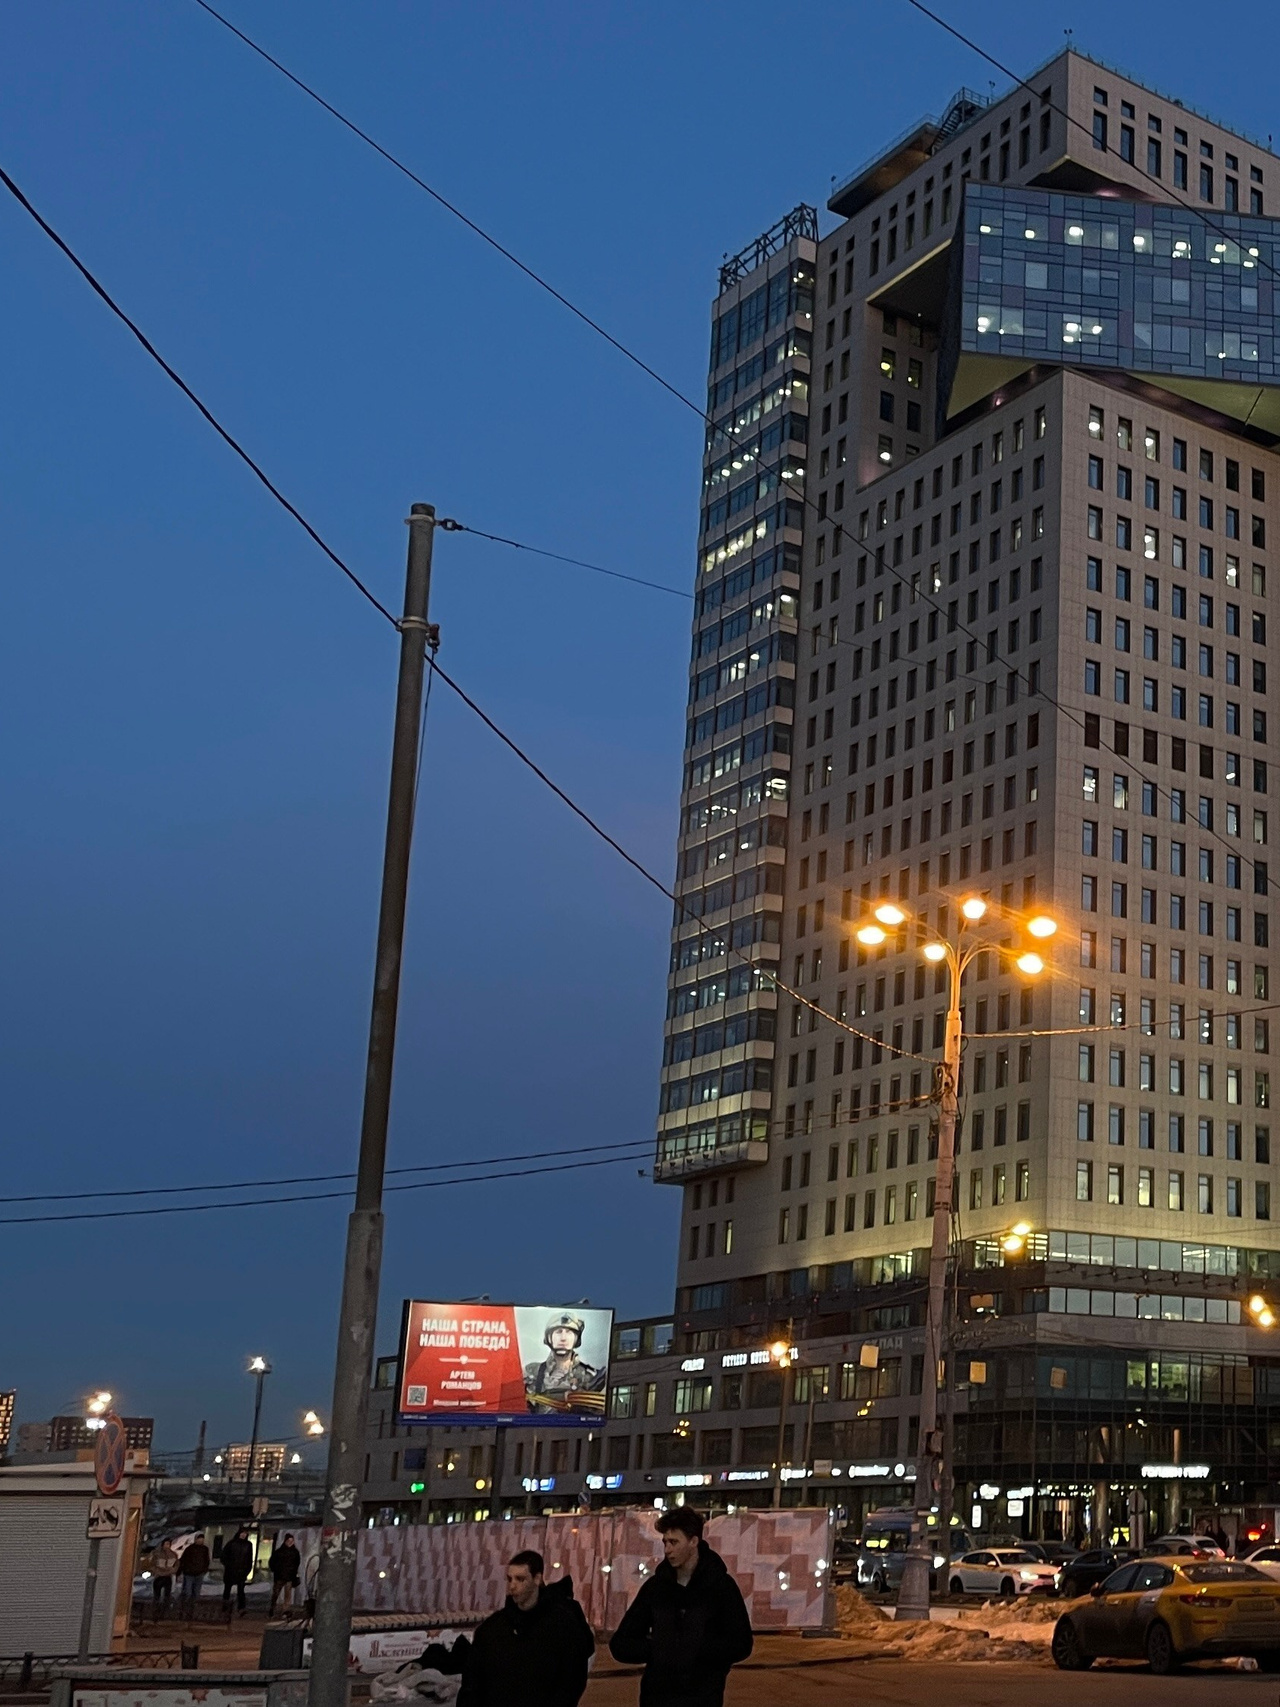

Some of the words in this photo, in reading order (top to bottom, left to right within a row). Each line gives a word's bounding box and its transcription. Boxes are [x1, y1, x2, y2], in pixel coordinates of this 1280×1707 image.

[422, 1318, 458, 1332] НАША
[462, 1320, 510, 1337] СТРАНА,
[420, 1334, 456, 1348] НАША
[459, 1336, 510, 1351] ПОБЕДА!
